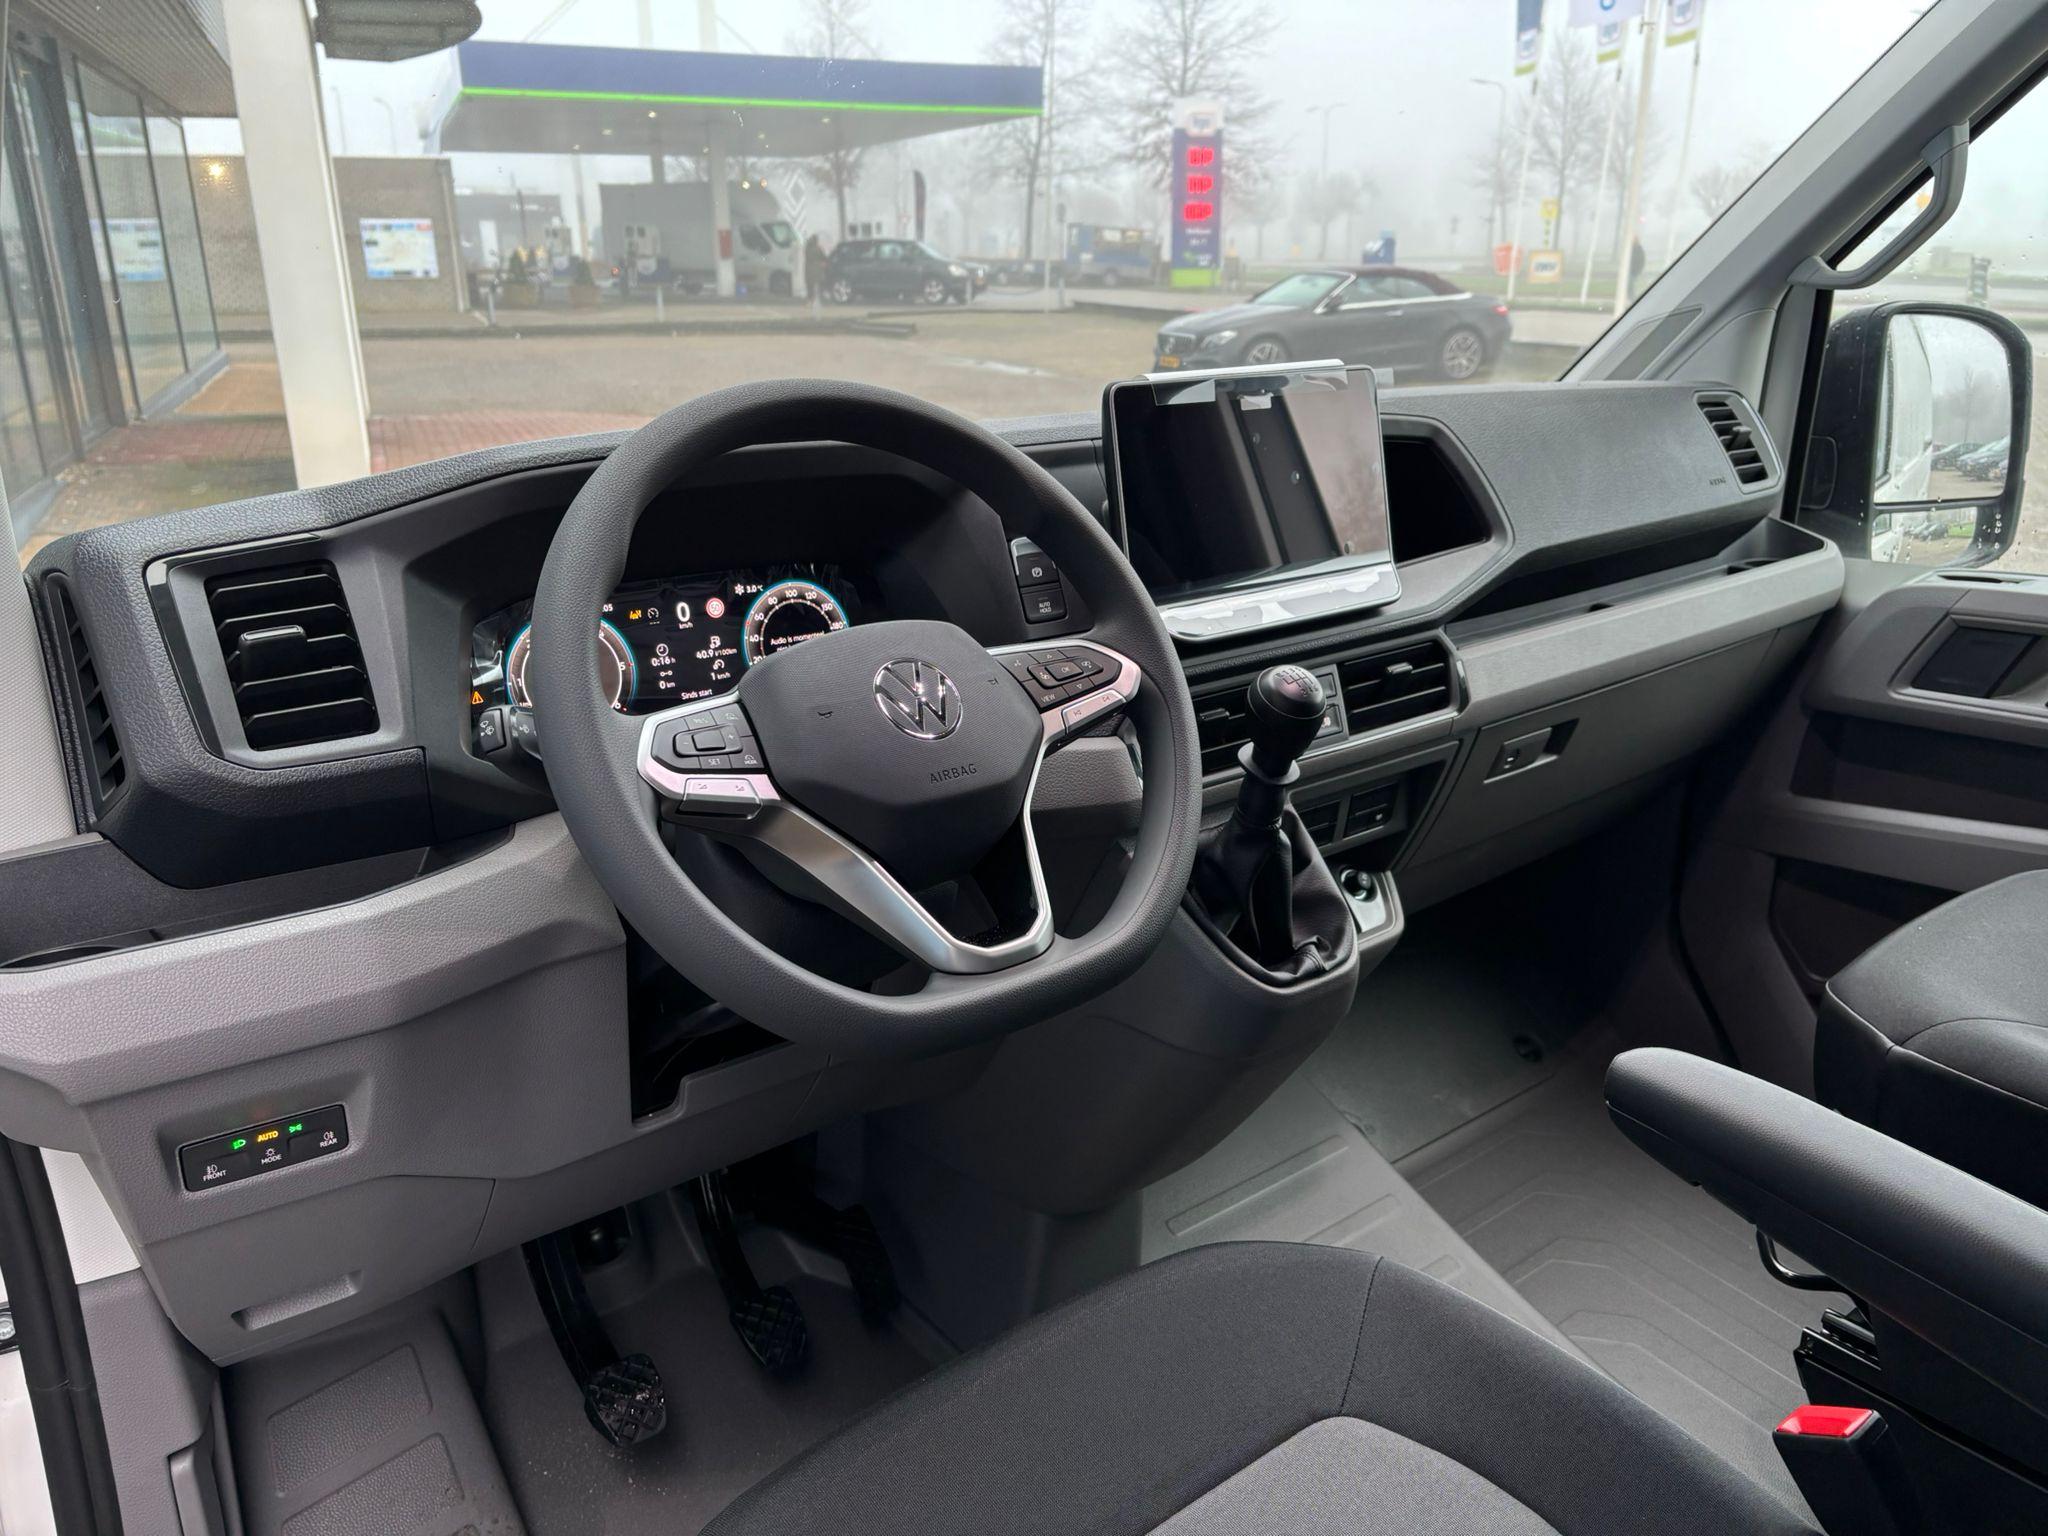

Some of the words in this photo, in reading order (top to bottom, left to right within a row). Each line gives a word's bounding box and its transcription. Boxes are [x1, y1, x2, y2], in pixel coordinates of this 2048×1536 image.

[785, 589, 798, 598] 100
[804, 591, 817, 600] 120
[767, 596, 778, 605] 80
[676, 601, 691, 622] 0
[821, 602, 833, 612] 150
[754, 612, 764, 621] 60
[678, 621, 694, 630] km/h
[832, 621, 844, 630] 180
[749, 634, 760, 643] 40
[770, 636, 787, 646] Audio
[696, 649, 714, 659] 40.9
[619, 661, 626, 671] 5
[651, 657, 671, 667] 0:16
[711, 672, 716, 681] 1
[717, 671, 731, 680] km/h
[659, 680, 666, 690] 0
[681, 690, 698, 700] Sinds
[699, 688, 713, 697] start
[1041, 693, 1056, 703] VIEW
[708, 758, 721, 766] SET
[929, 763, 978, 785] AIRBAG
[257, 1130, 279, 1143] AUTO
[319, 1137, 338, 1148] REAR
[261, 1153, 282, 1165] MODE
[202, 1169, 227, 1182] FRONT
